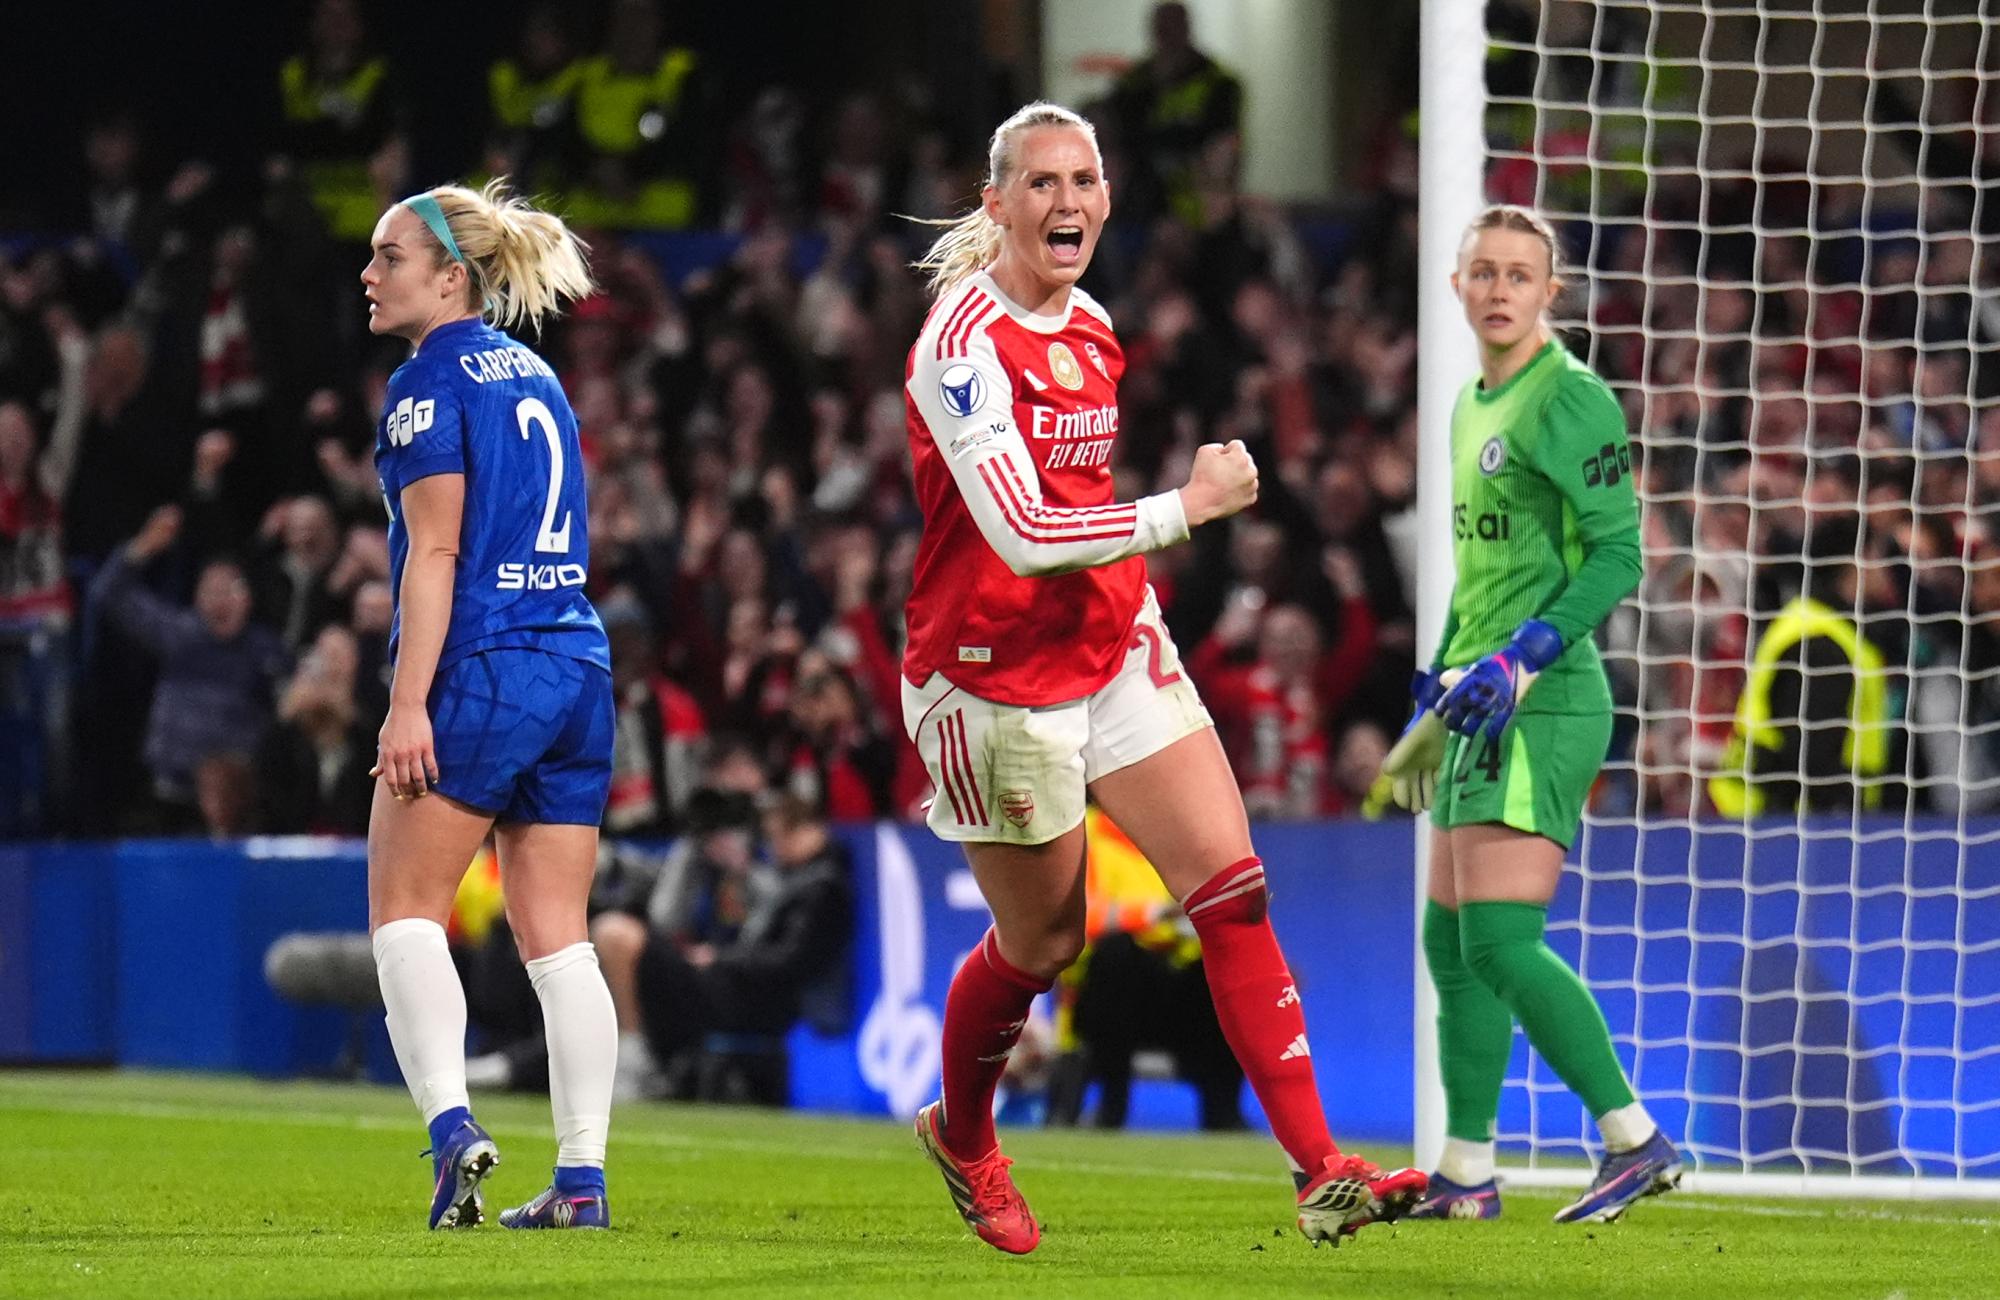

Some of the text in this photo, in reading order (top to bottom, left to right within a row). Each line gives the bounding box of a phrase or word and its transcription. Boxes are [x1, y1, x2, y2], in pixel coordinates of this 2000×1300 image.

[387, 397, 436, 447] FPT
[516, 397, 571, 553] 2
[1045, 443, 1074, 469] FLY
[1130, 616, 1184, 690] 2
